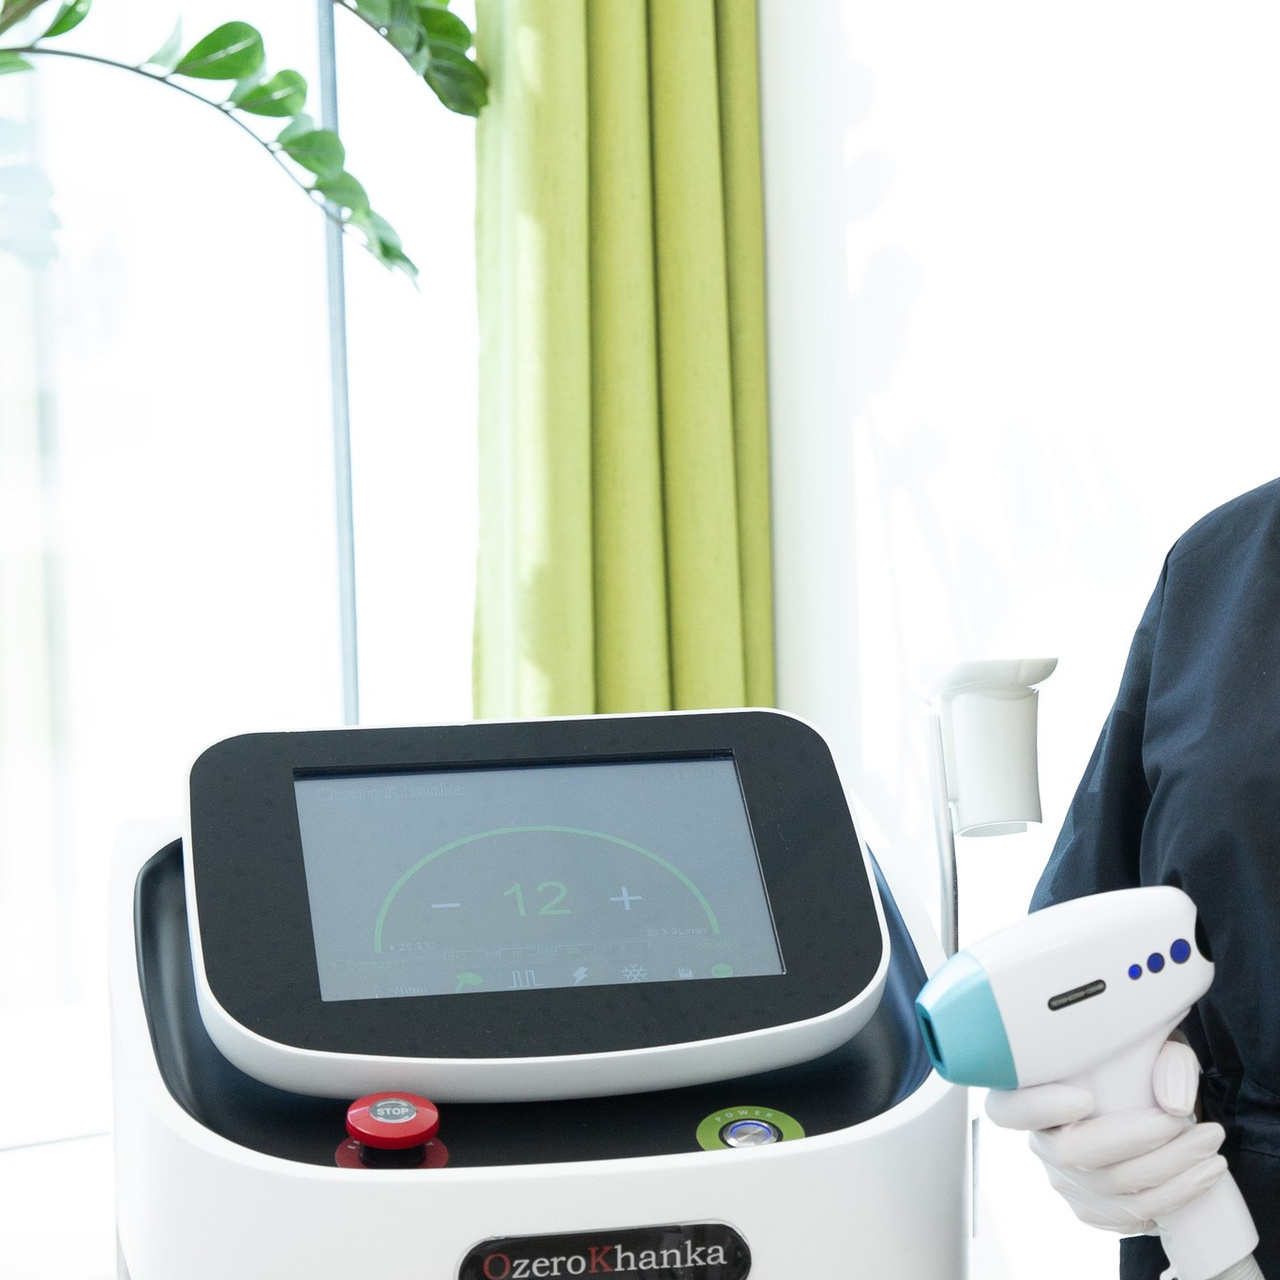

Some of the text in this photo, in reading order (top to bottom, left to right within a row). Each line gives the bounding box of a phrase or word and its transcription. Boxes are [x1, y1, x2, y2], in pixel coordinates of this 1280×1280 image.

[503, 880, 572, 917] 12
[377, 1107, 409, 1116] STOP
[715, 1110, 773, 1122] POWER
[483, 1240, 727, 1280] OzeroKhanka
